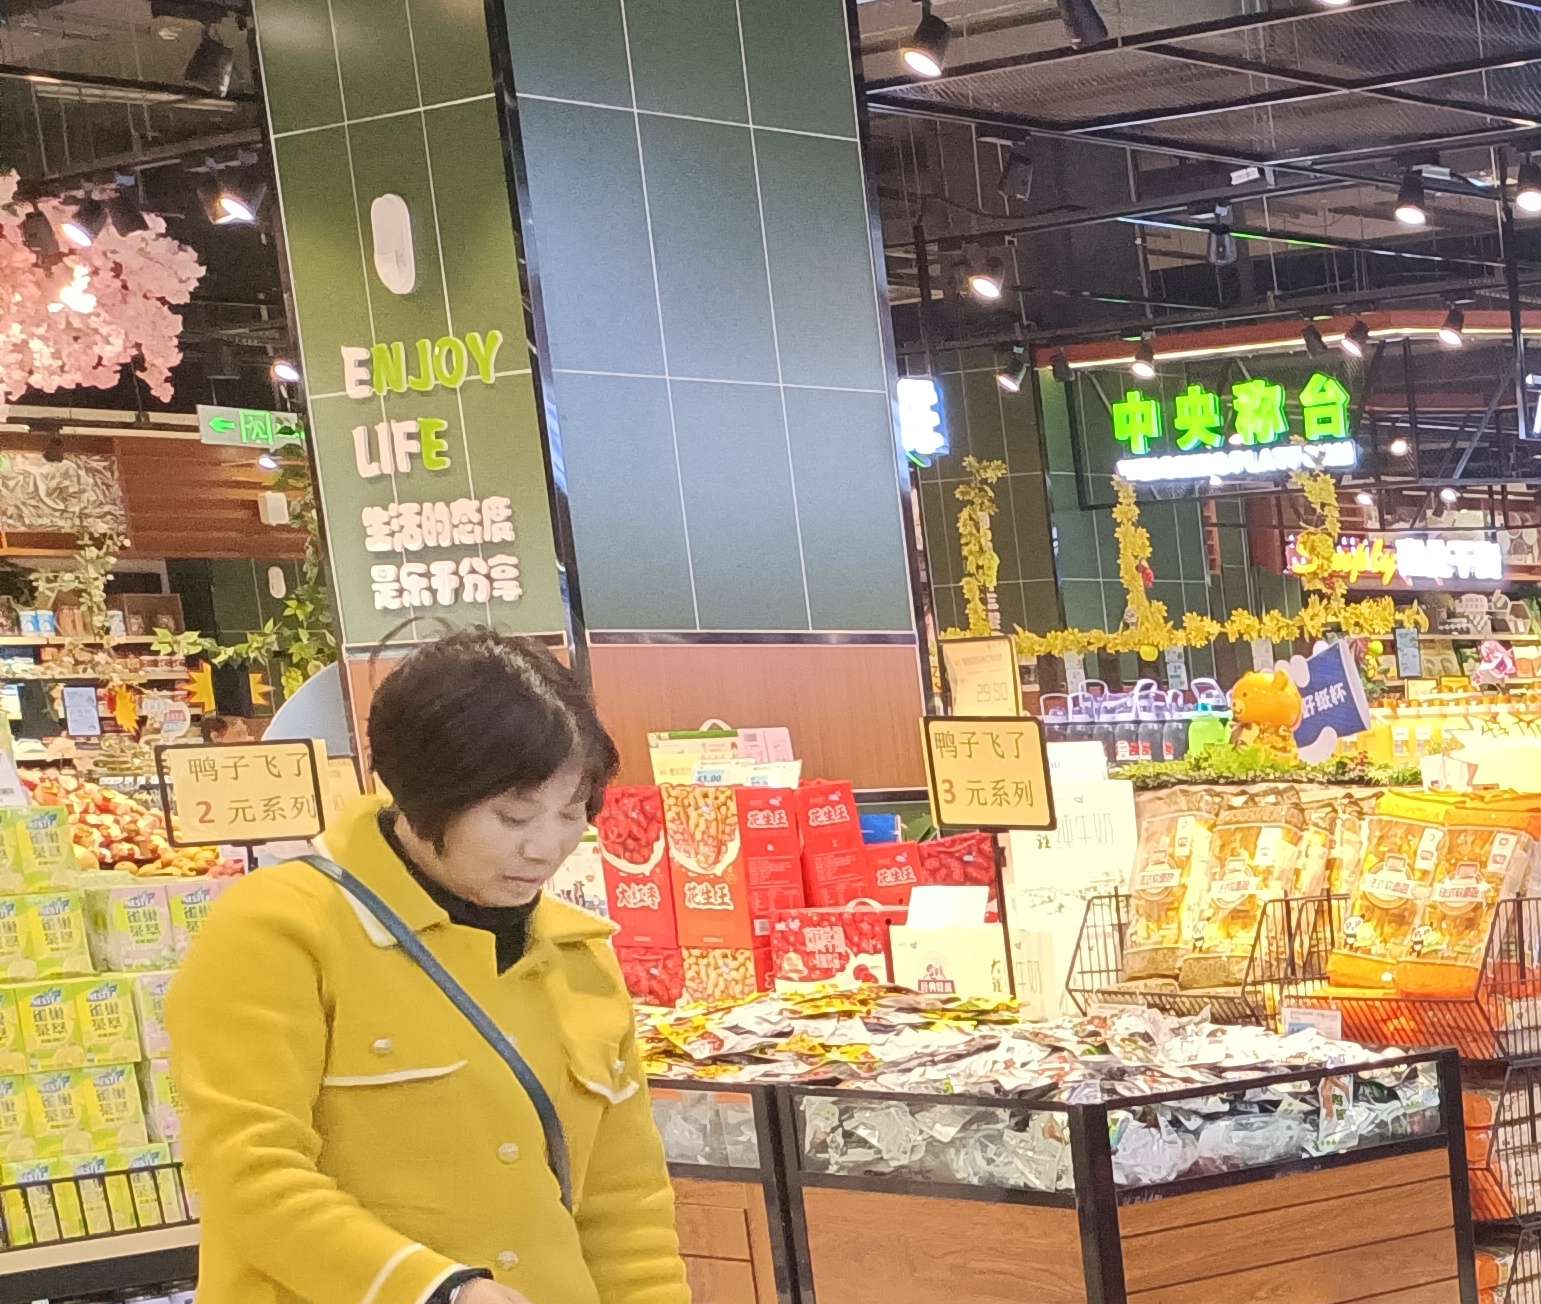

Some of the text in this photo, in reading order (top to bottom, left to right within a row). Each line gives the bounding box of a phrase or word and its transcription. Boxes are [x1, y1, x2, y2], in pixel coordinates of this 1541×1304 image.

[341, 330, 503, 399] ENJOY
[1112, 372, 1351, 454] 中央称台
[352, 417, 451, 478] LIFE
[362, 496, 515, 552] 生活的态度
[370, 553, 522, 610] 是乐于分享
[935, 731, 1024, 759] 鸭子飞了
[189, 752, 308, 783] 鸭子飞了
[941, 779, 1033, 807] 3 元系列
[196, 794, 316, 825] 2 元系列
[748, 808, 788, 829] 花生王
[808, 804, 849, 826] 花生王
[877, 864, 916, 886] 花生王
[617, 883, 661, 910] 大红枣
[684, 882, 734, 910] 花生王
